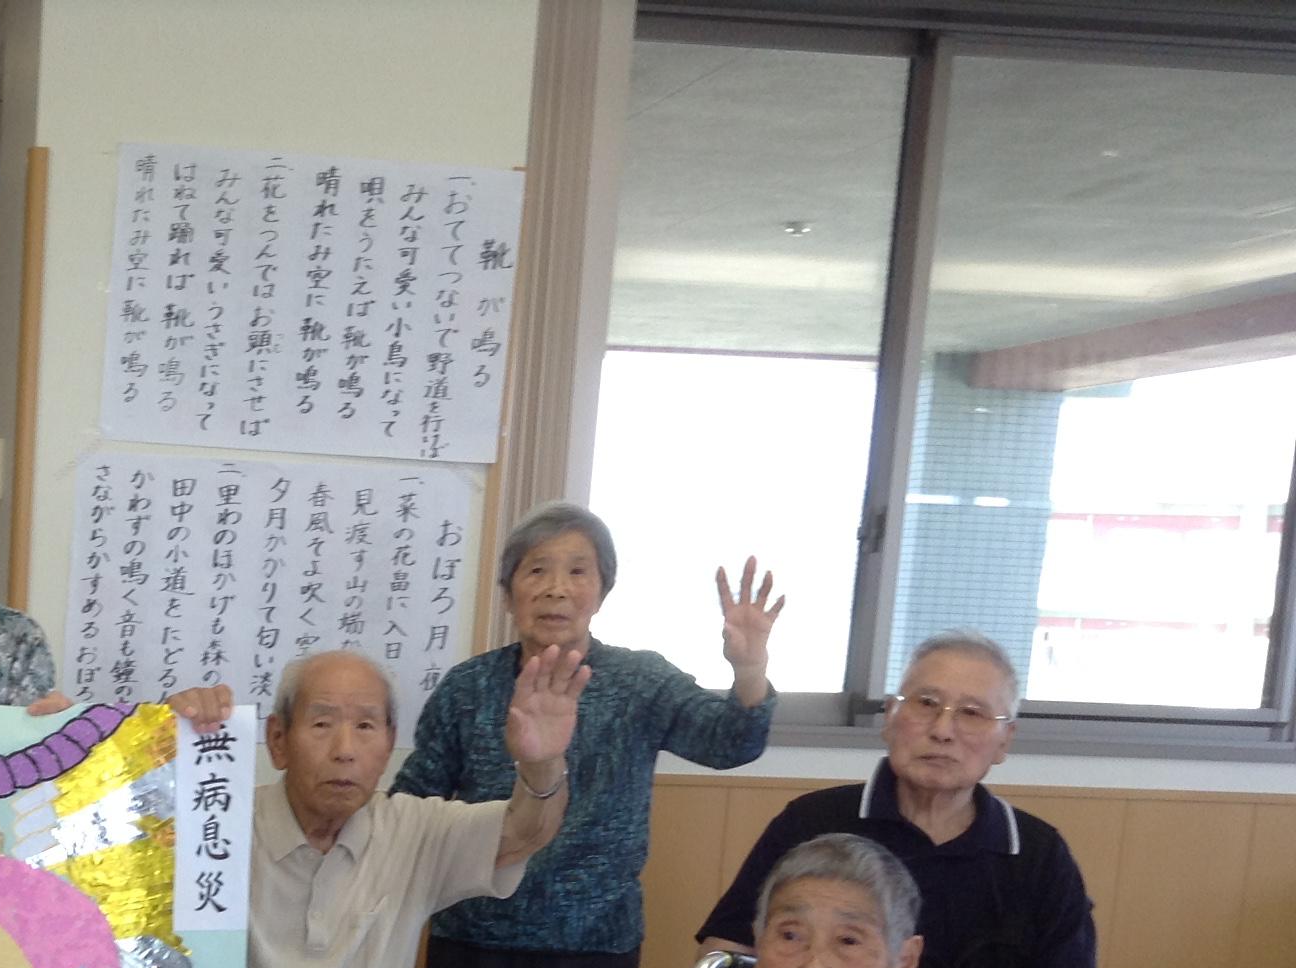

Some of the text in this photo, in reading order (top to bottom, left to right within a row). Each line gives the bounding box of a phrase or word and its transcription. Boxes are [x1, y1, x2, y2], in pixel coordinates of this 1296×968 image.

[470, 239, 513, 388] 靴が鳴る
[109, 469, 155, 703] かわずの鳴く音も鐘の
[191, 724, 238, 914] 無病息災
